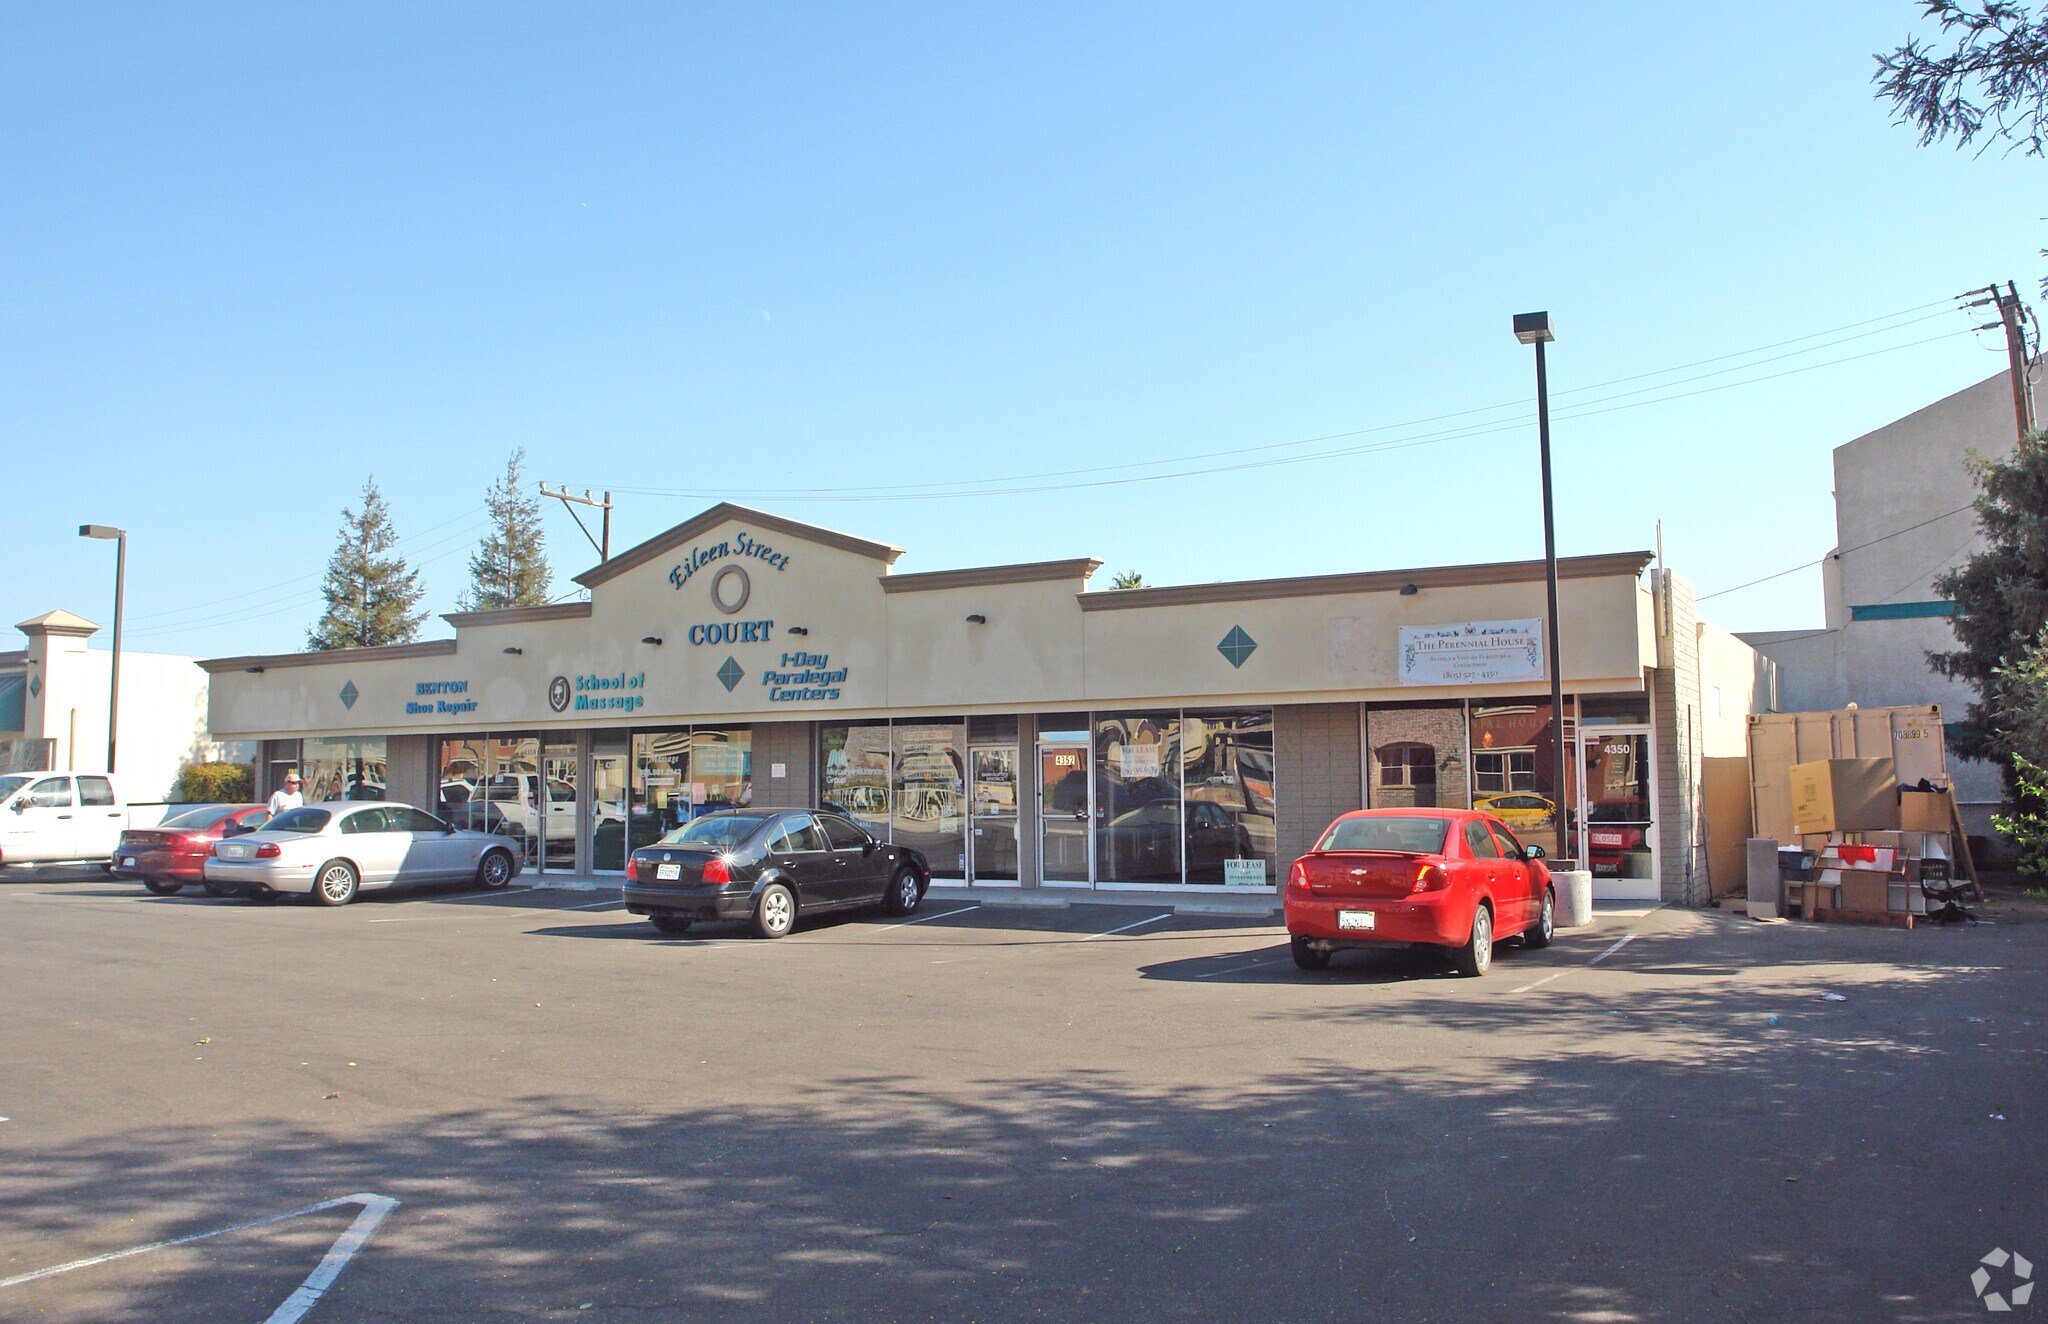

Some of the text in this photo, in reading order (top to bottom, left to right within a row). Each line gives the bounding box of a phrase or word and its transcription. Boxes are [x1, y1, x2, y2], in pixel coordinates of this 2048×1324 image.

[669, 532, 790, 590] Eileen Street
[688, 620, 774, 645] COURT
[781, 652, 828, 669] 1-Day
[575, 672, 645, 691] School of
[762, 667, 848, 687] Paralegal
[1443, 672, 1461, 680] (805)
[1463, 671, 1475, 679] 527
[415, 680, 468, 695] BENTON
[769, 687, 840, 701] Centers
[406, 699, 478, 715] Shoe Repair
[574, 694, 644, 712] Massage
[1604, 745, 1630, 754] 4350
[1056, 755, 1075, 765] 4352
[827, 776, 846, 784] Group
[1593, 834, 1620, 843] CLOSED
